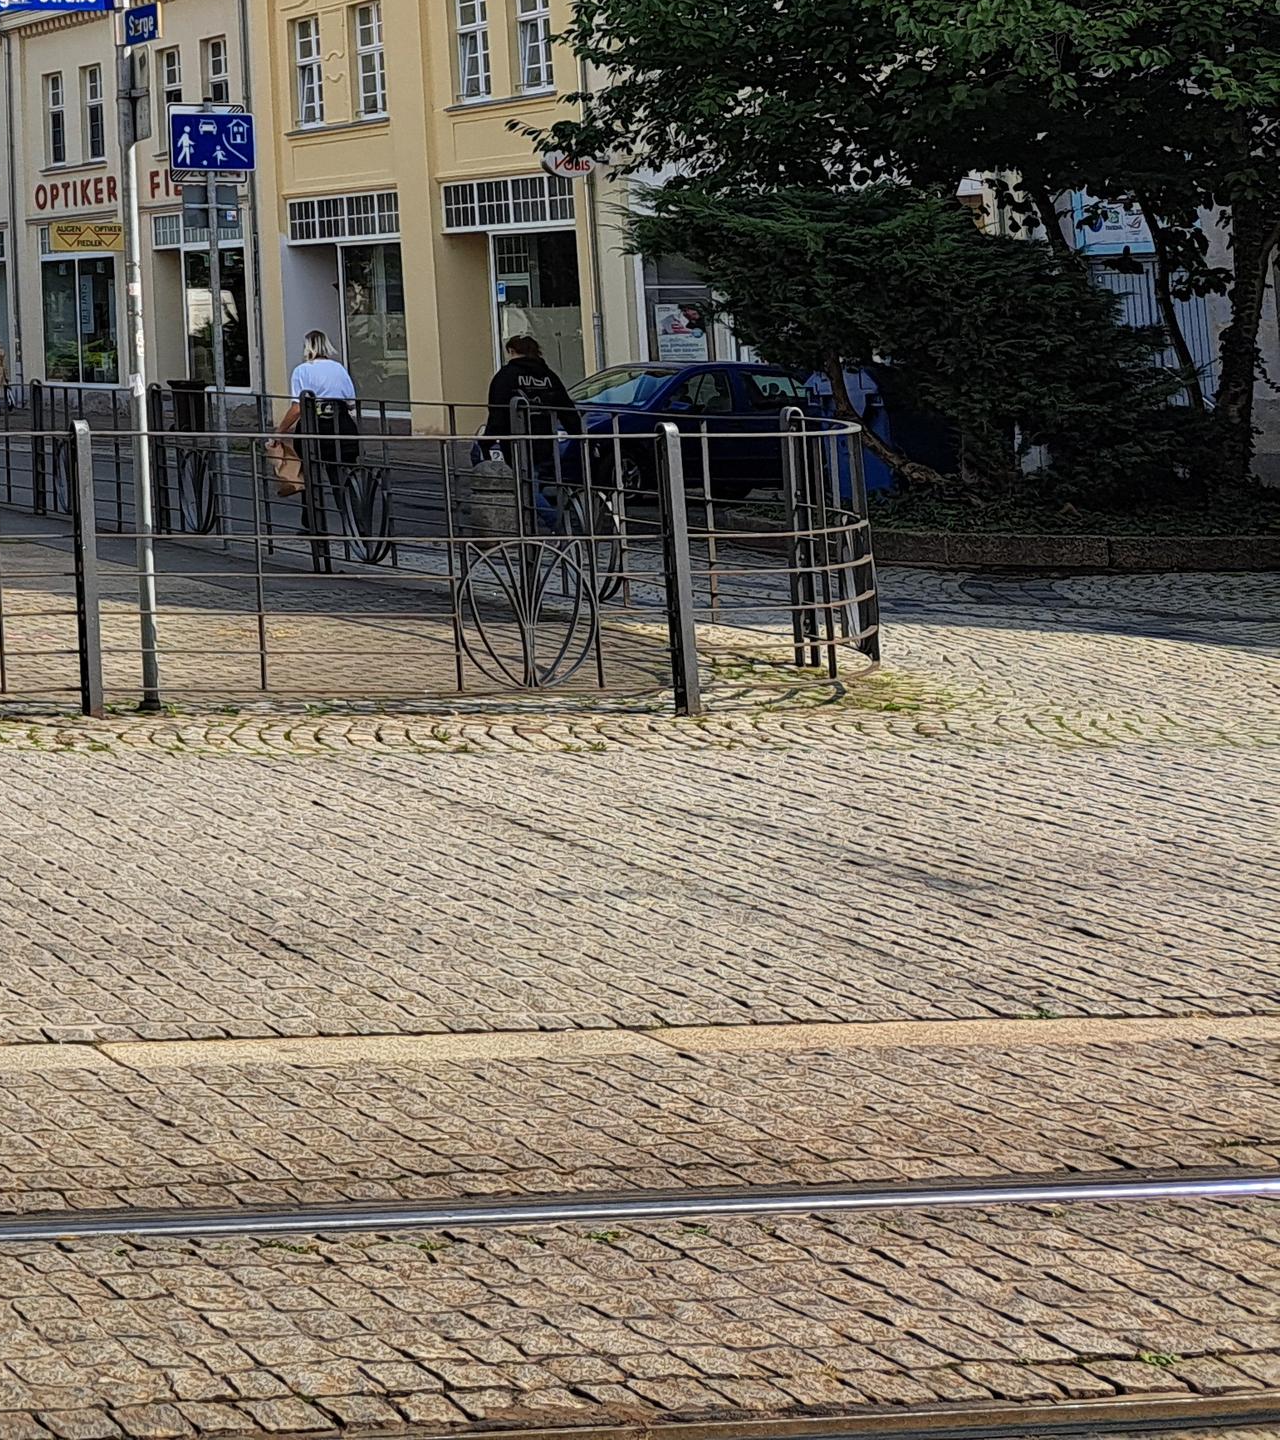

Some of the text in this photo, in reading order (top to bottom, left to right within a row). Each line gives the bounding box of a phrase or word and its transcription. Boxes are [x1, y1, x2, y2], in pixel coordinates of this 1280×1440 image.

[34, 175, 118, 210] OPTIKER
[56, 225, 122, 234] AUGEN OPTIKER
[76, 239, 102, 248] FIEDLER
[518, 376, 552, 388] NASA
